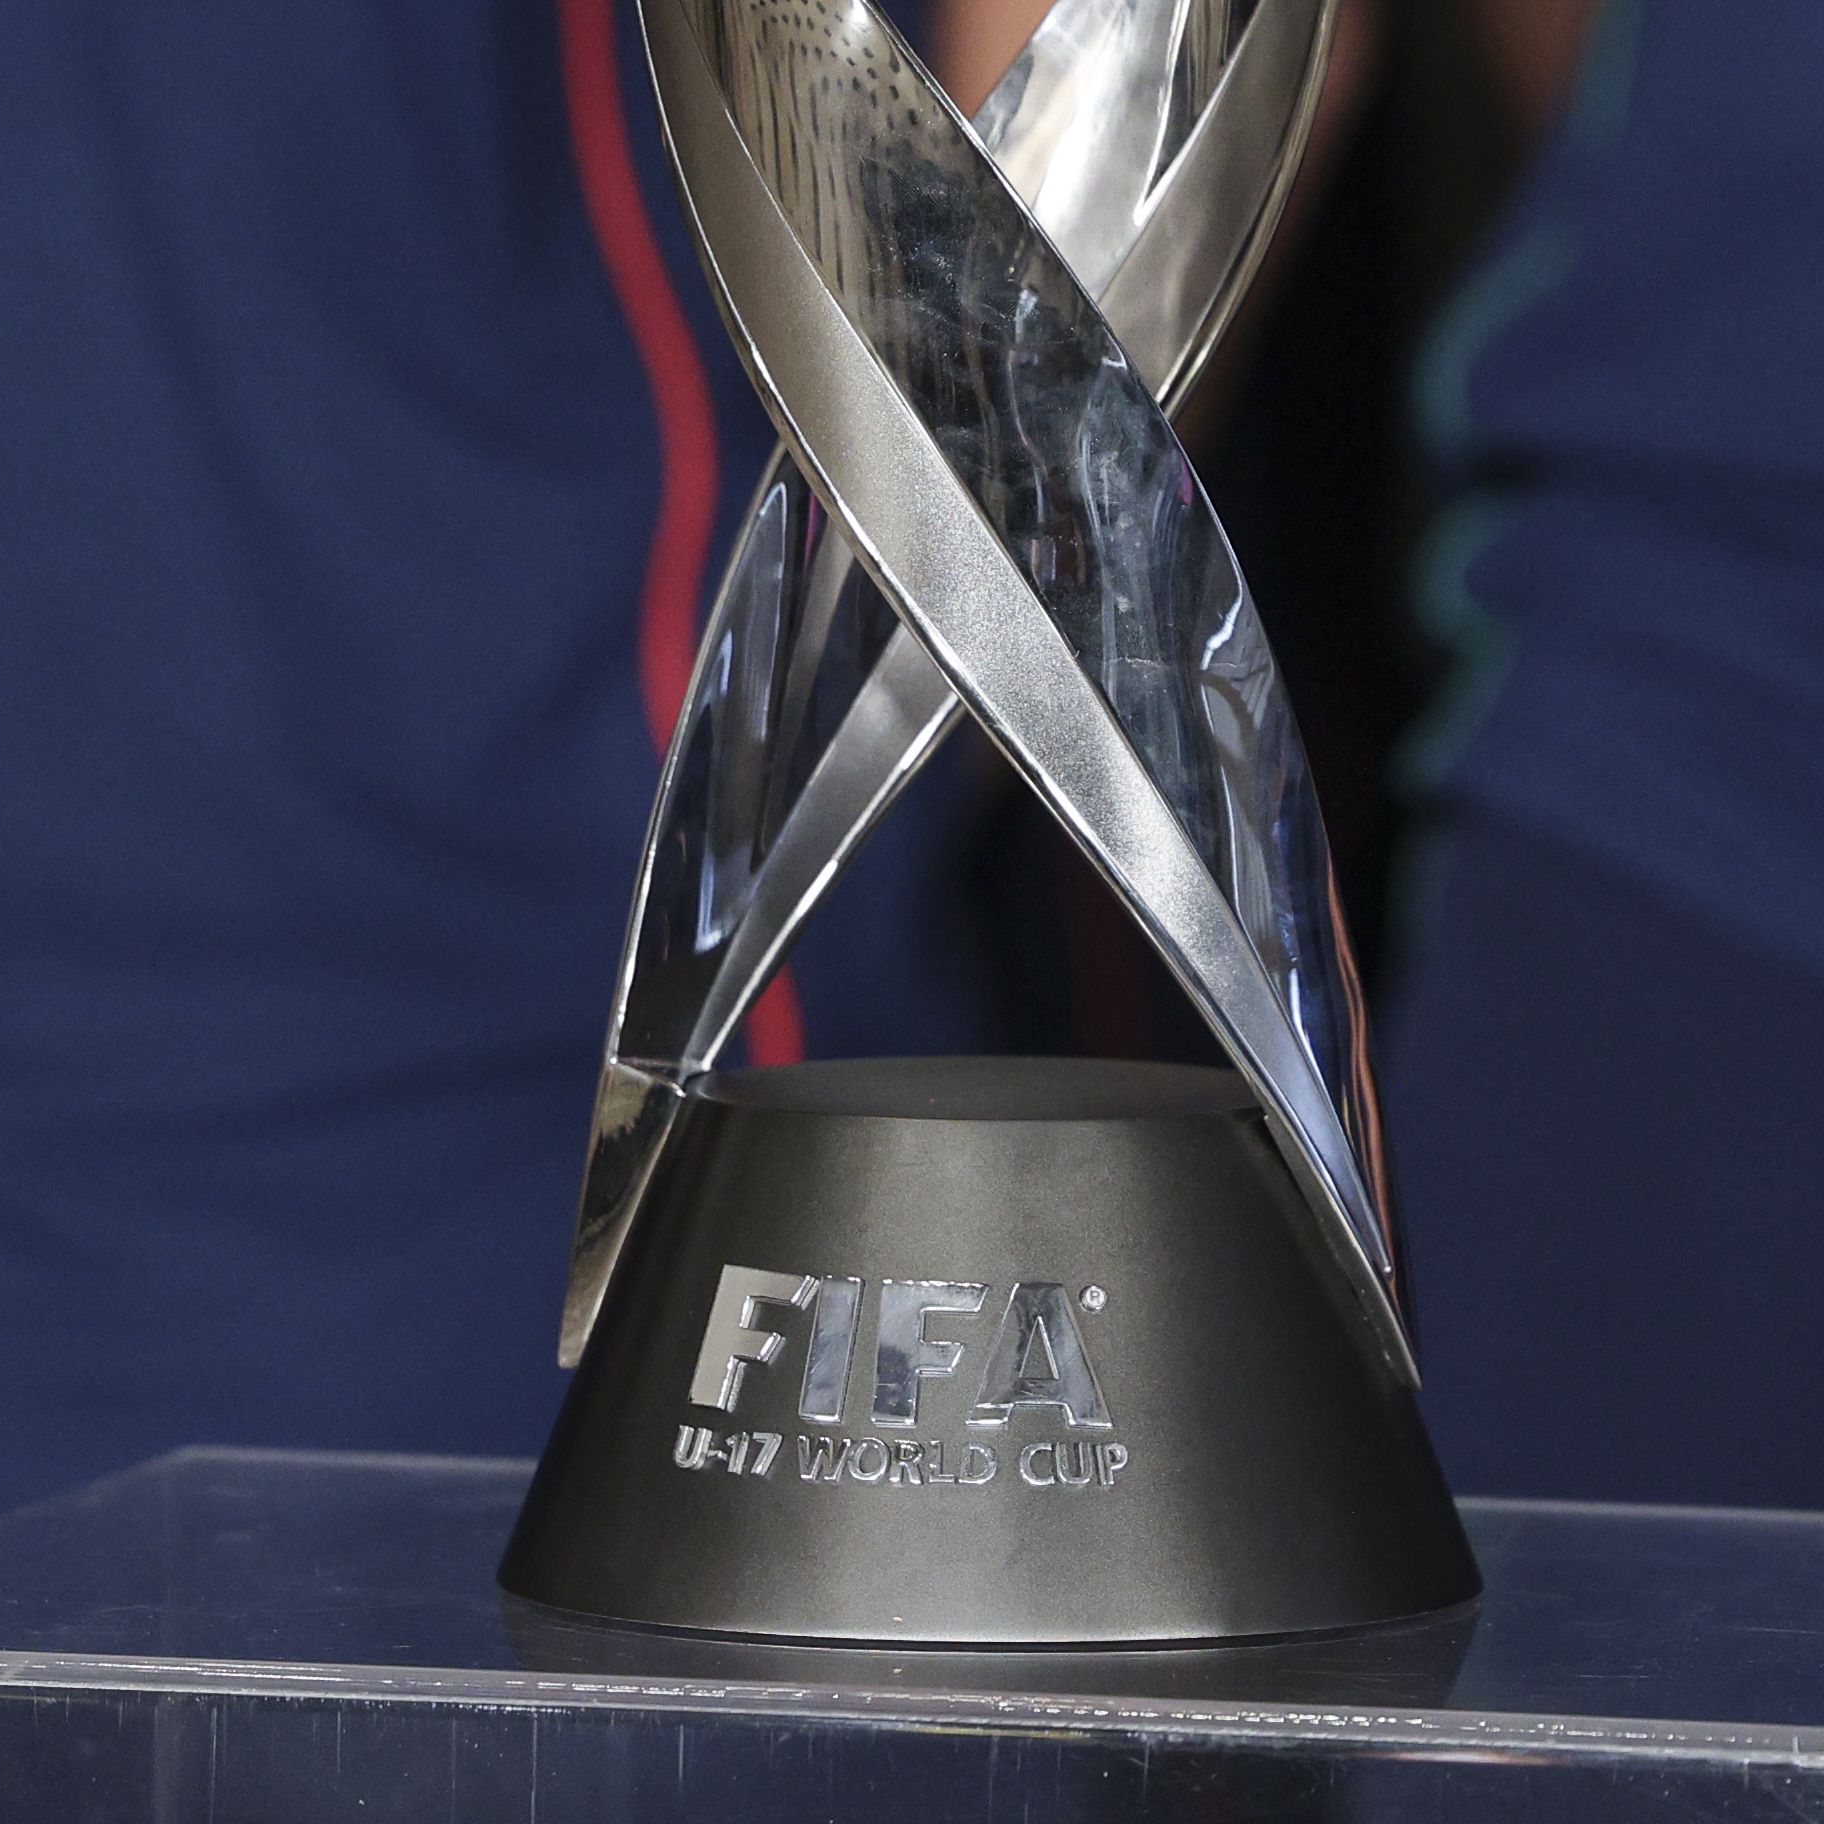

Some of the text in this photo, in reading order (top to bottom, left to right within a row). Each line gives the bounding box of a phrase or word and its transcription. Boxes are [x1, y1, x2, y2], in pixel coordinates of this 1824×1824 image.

[675, 1424, 1129, 1487] U-17 WORLD CUP
